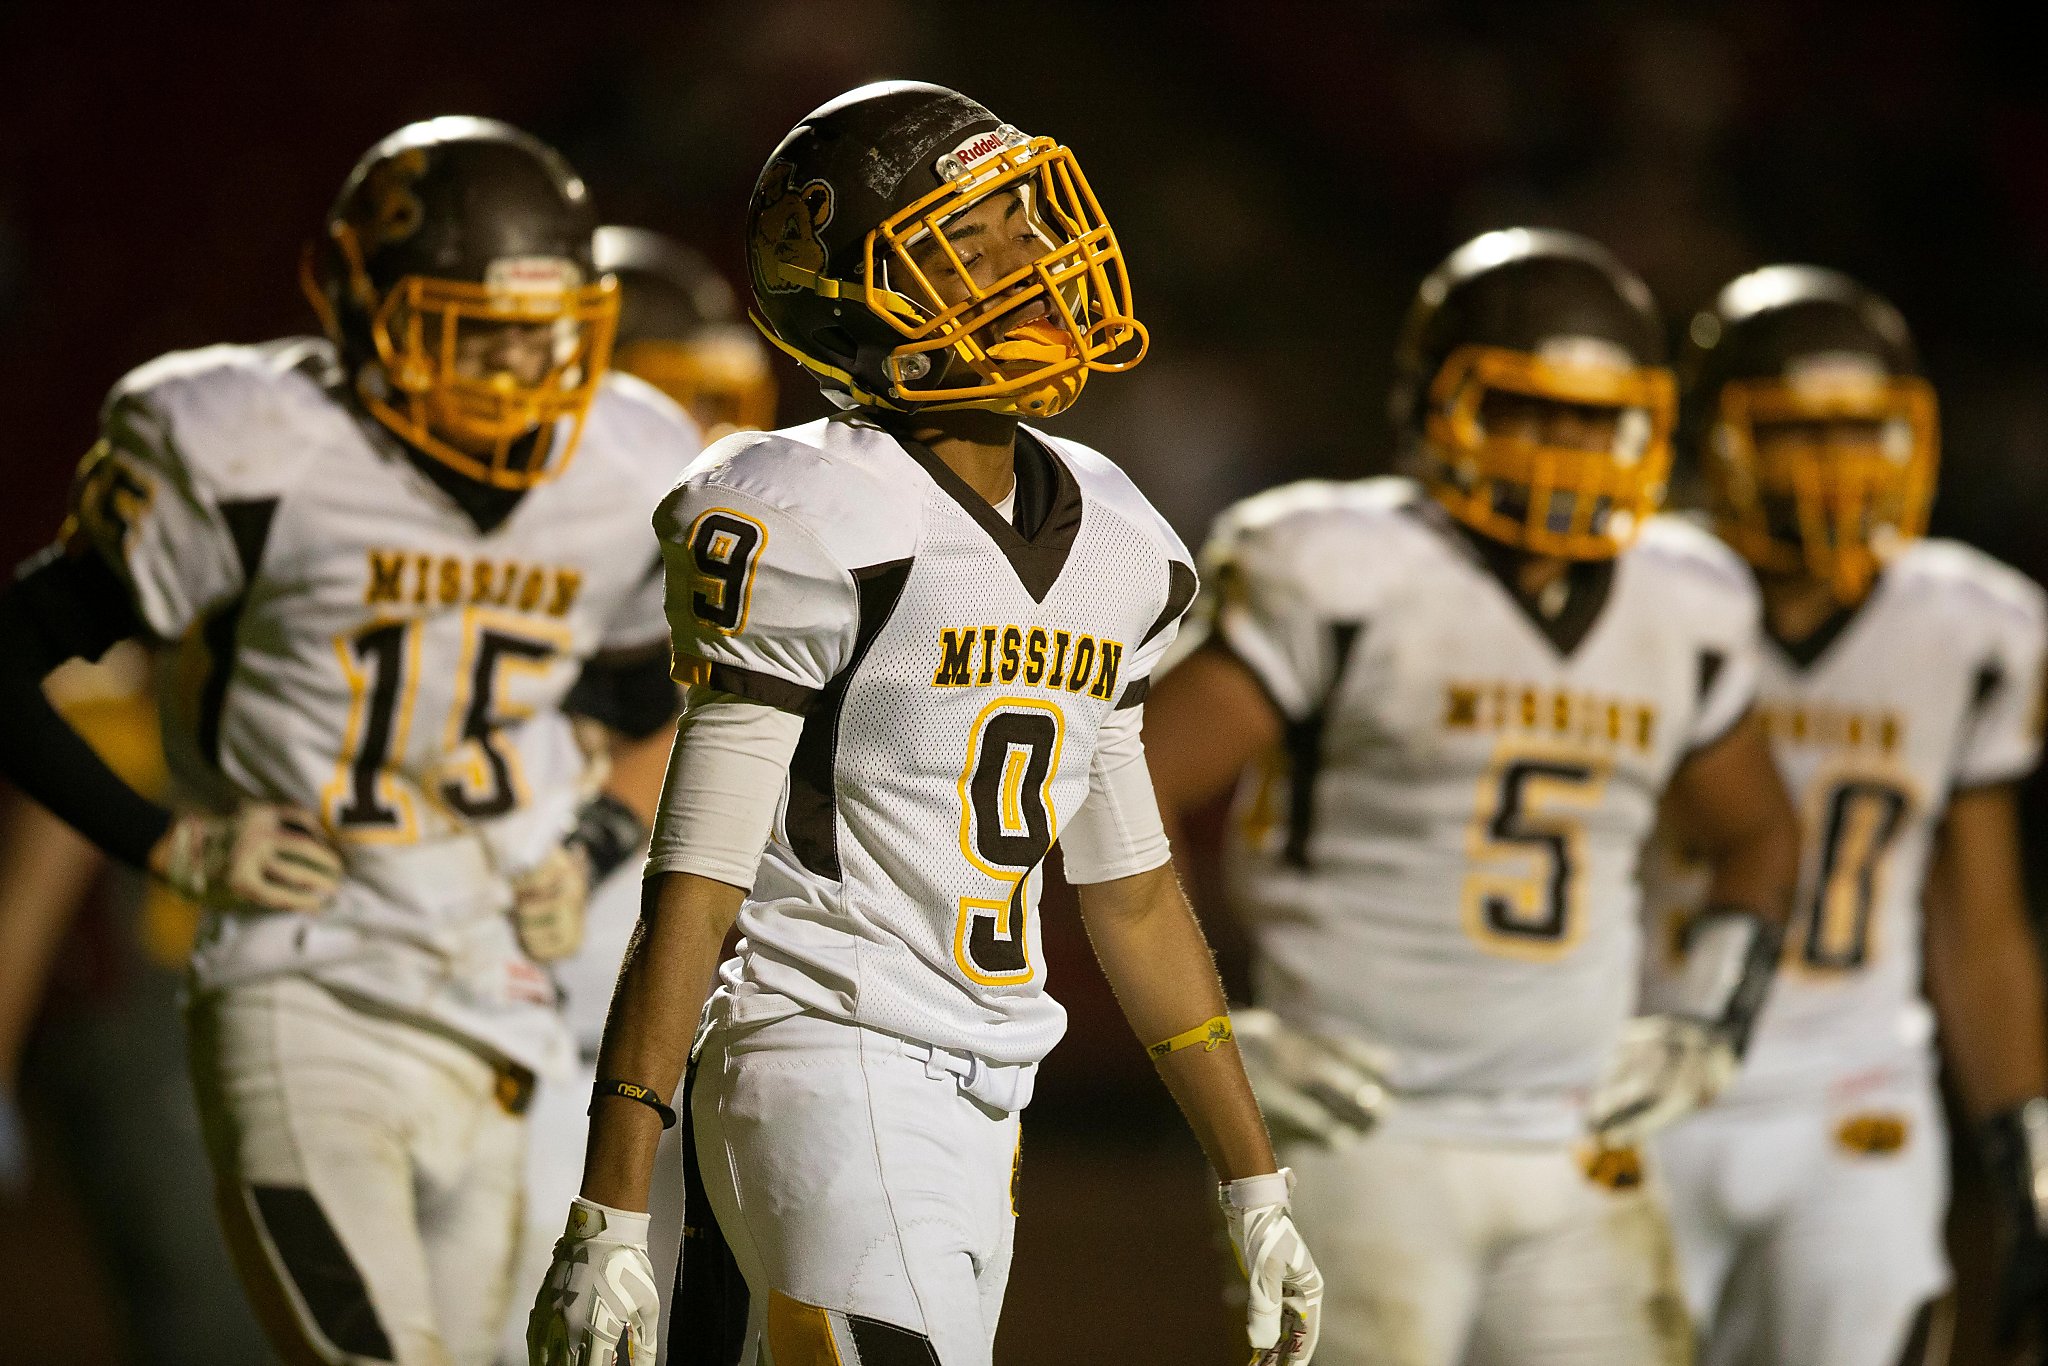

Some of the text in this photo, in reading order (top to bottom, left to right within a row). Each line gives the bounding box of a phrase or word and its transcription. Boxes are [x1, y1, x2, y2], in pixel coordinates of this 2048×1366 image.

[956, 133, 1004, 165] Riddell
[366, 549, 583, 618] MISSION
[687, 506, 769, 637] 9
[931, 624, 1123, 701] MISSION
[321, 605, 575, 845] 15
[954, 696, 1065, 986] 9
[1460, 740, 1612, 963] 5
[617, 1083, 648, 1099] ASU
